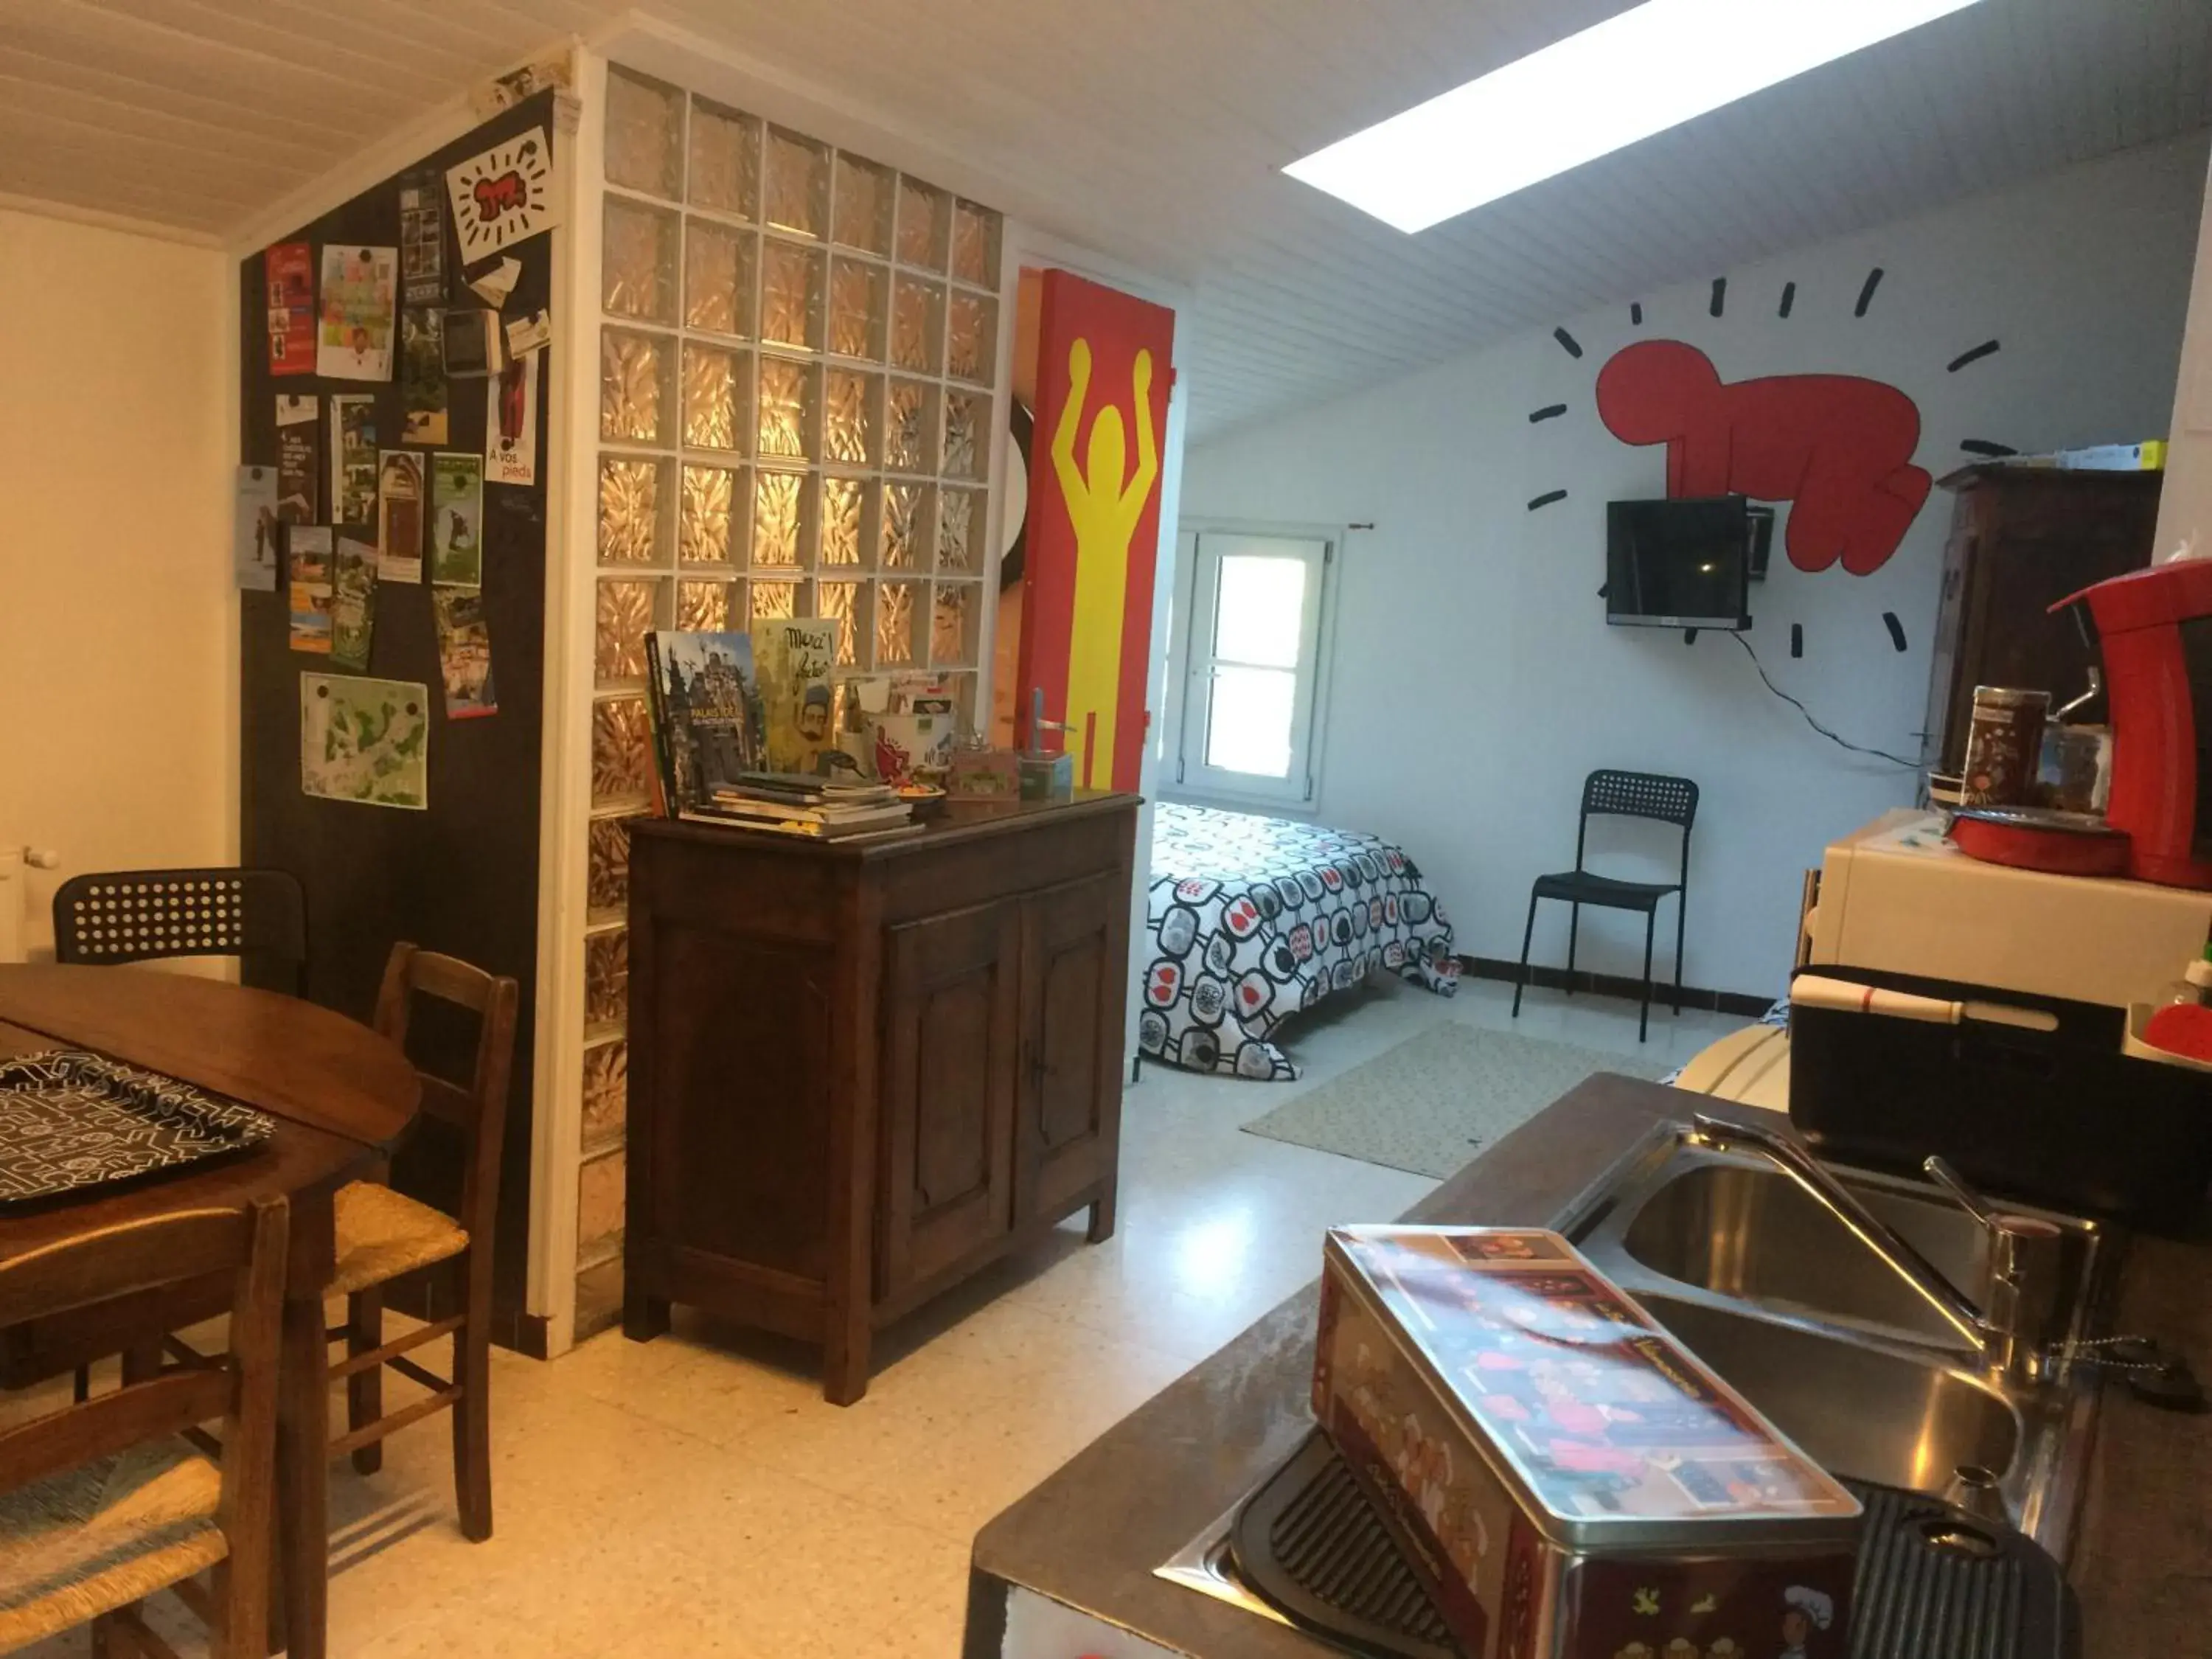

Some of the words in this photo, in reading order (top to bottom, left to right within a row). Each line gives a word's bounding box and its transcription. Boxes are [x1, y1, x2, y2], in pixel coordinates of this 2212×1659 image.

[499, 452, 518, 464] vos
[502, 464, 532, 480] pieds
[785, 627, 824, 650] Merci
